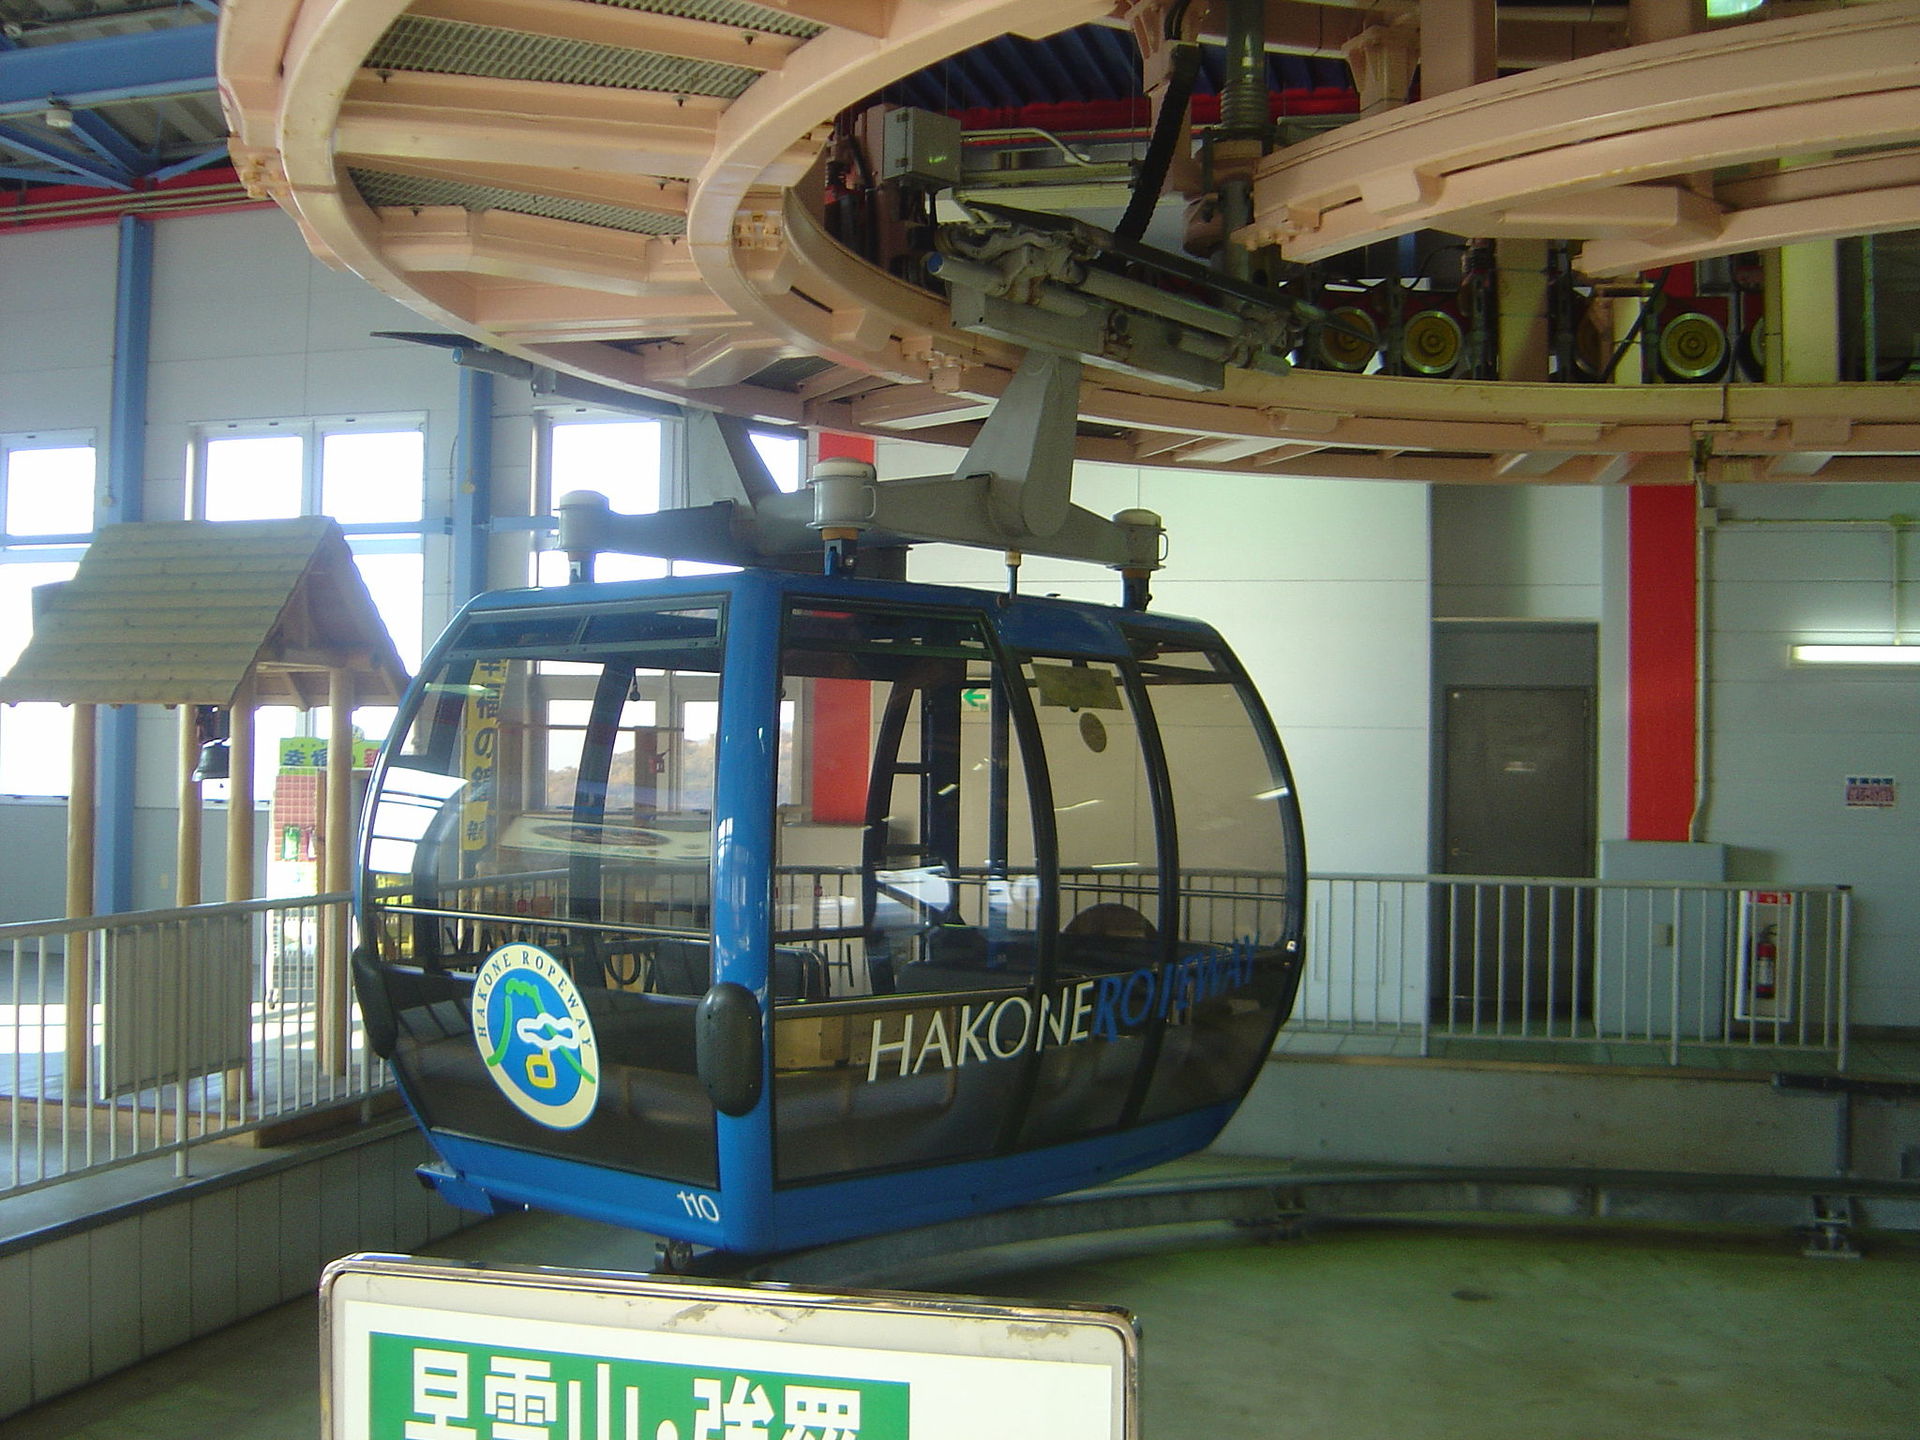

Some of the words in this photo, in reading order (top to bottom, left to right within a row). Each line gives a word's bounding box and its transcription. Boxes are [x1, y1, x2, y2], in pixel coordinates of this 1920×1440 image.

[477, 952, 512, 1038] HAKONE
[522, 950, 592, 1048] ROPEWAY
[868, 979, 1095, 1082] HAKONE
[676, 1190, 719, 1222] 110
